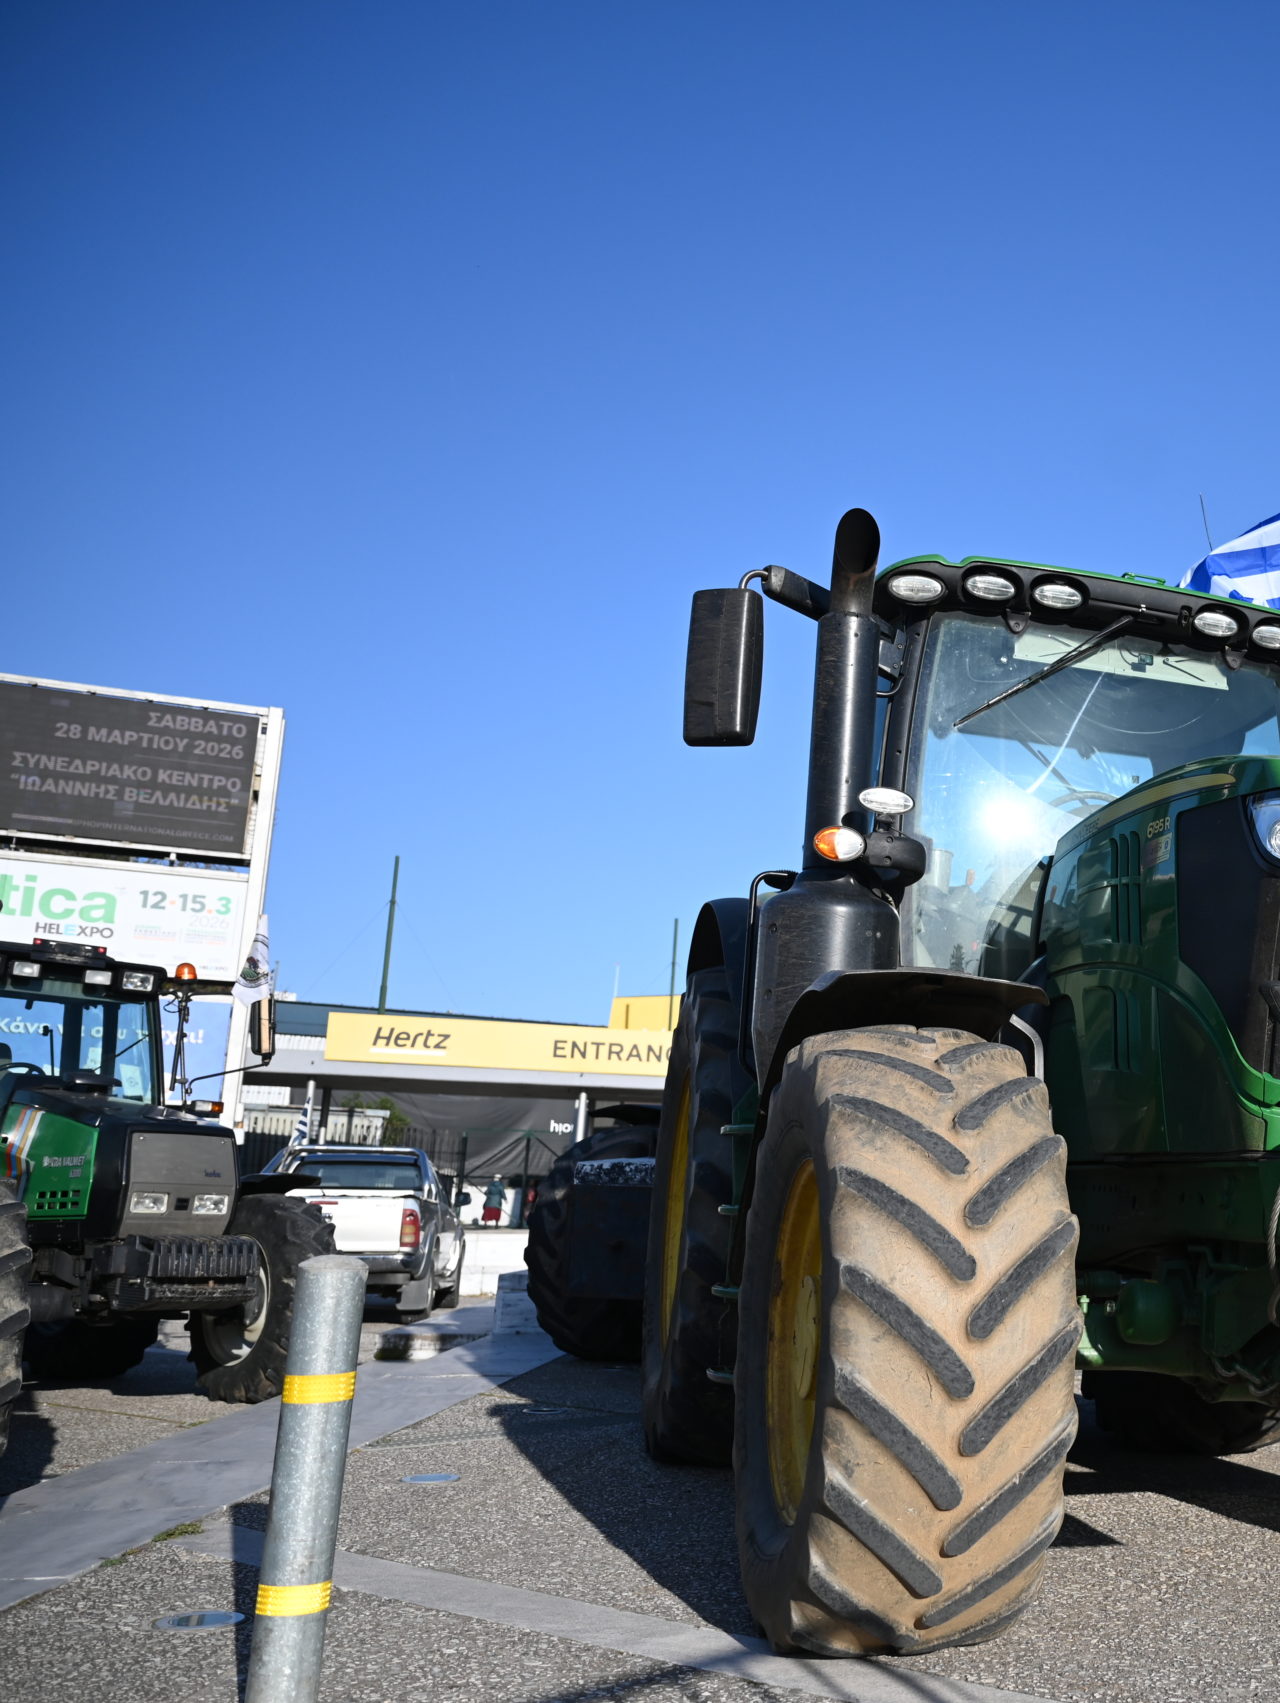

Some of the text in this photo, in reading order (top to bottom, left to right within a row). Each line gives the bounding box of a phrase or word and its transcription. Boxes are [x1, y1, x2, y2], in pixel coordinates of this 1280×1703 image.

[147, 711, 247, 738] ΣΑΒΒΑΤΟ
[54, 722, 244, 760] 28 ΜΑΡΤΙΟΥ 2026
[11, 751, 242, 792] ΣΥΝΕΔΡΙΑΚΟ ΚΕΝΤΡΟ
[34, 922, 114, 939] HELEXPO
[372, 1026, 451, 1050] Hertz
